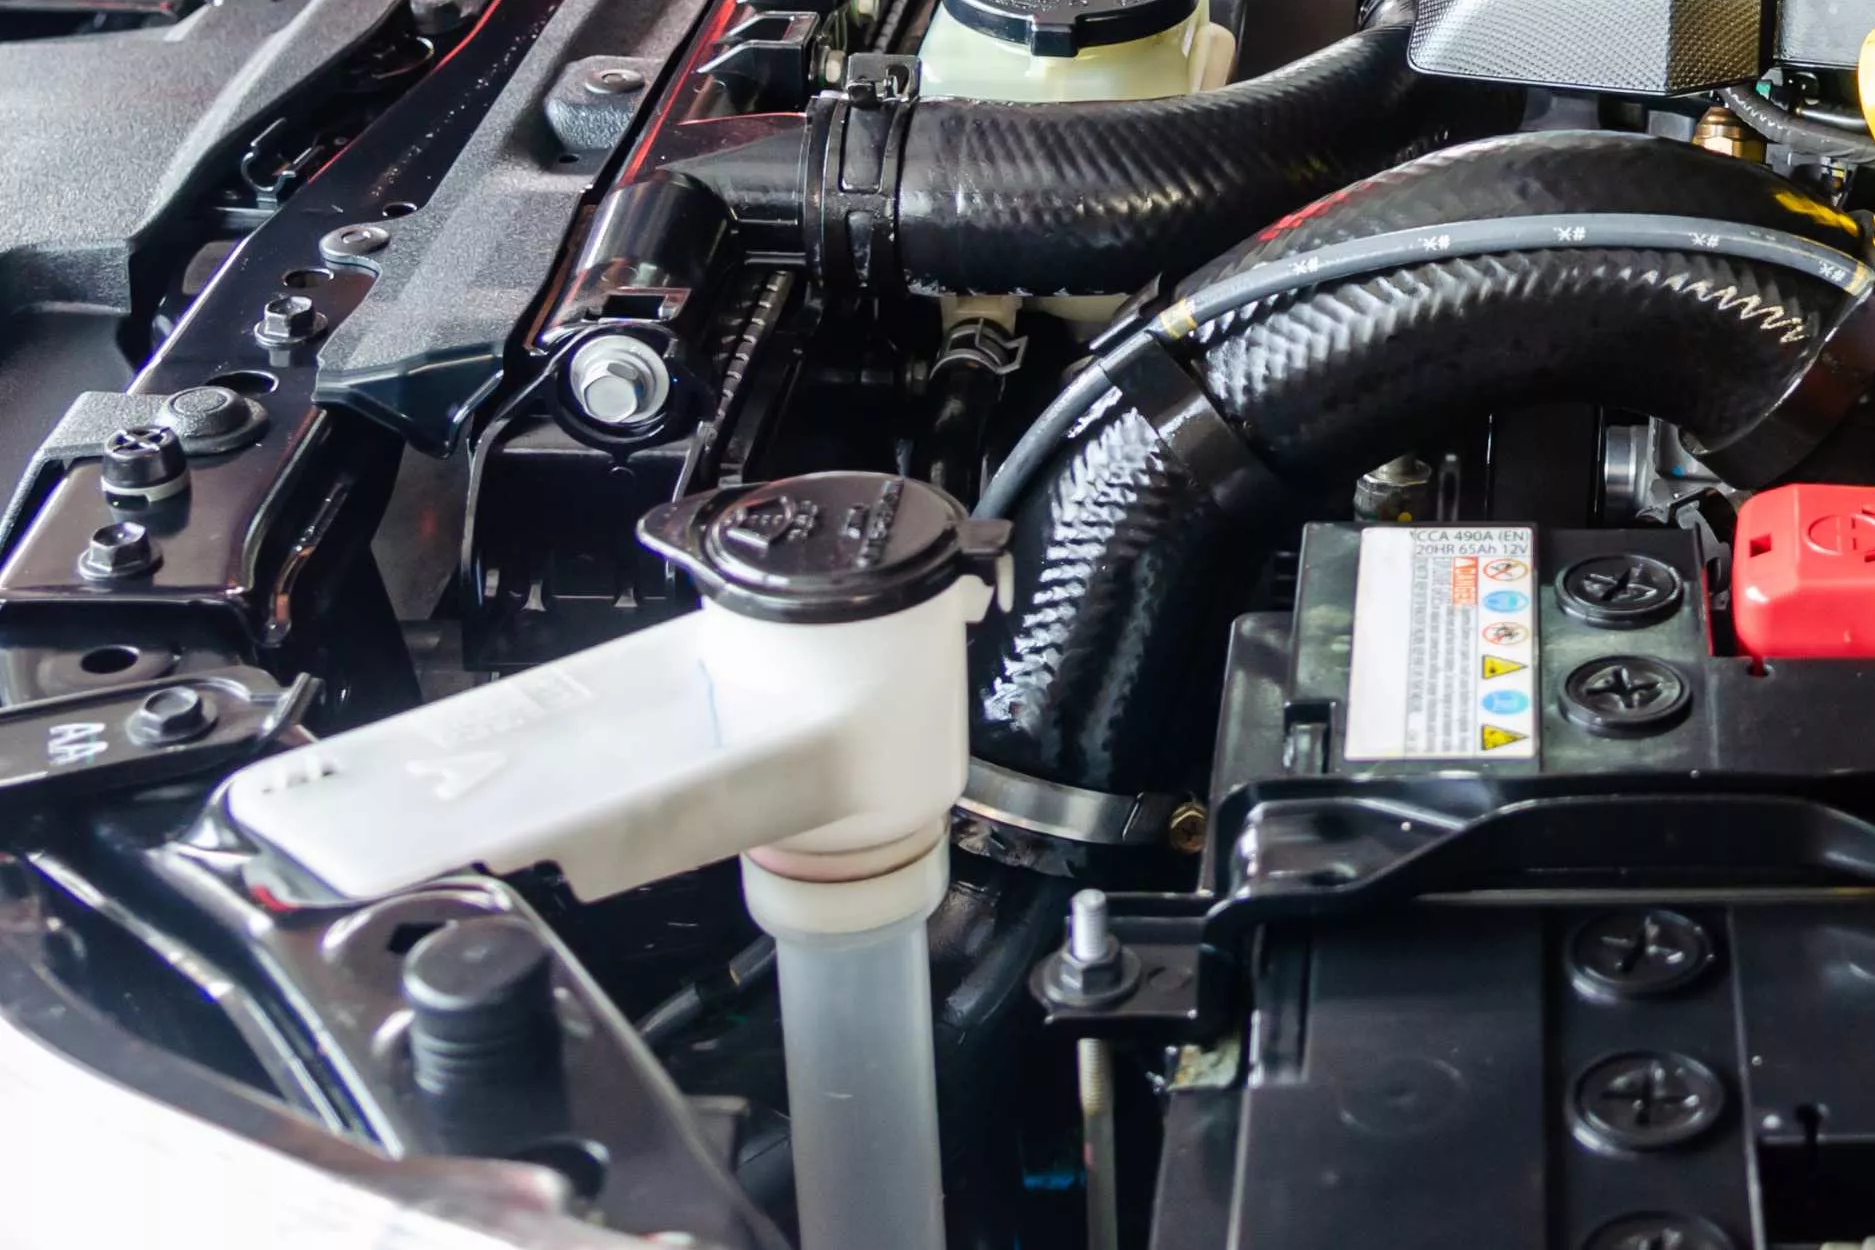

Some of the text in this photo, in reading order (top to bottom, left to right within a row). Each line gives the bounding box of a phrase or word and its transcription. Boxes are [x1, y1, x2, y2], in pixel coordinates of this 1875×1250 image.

[1454, 531, 1493, 542] 490A
[1499, 530, 1529, 542] (EN)
[1416, 544, 1529, 555] 20HR 65Ah 12V
